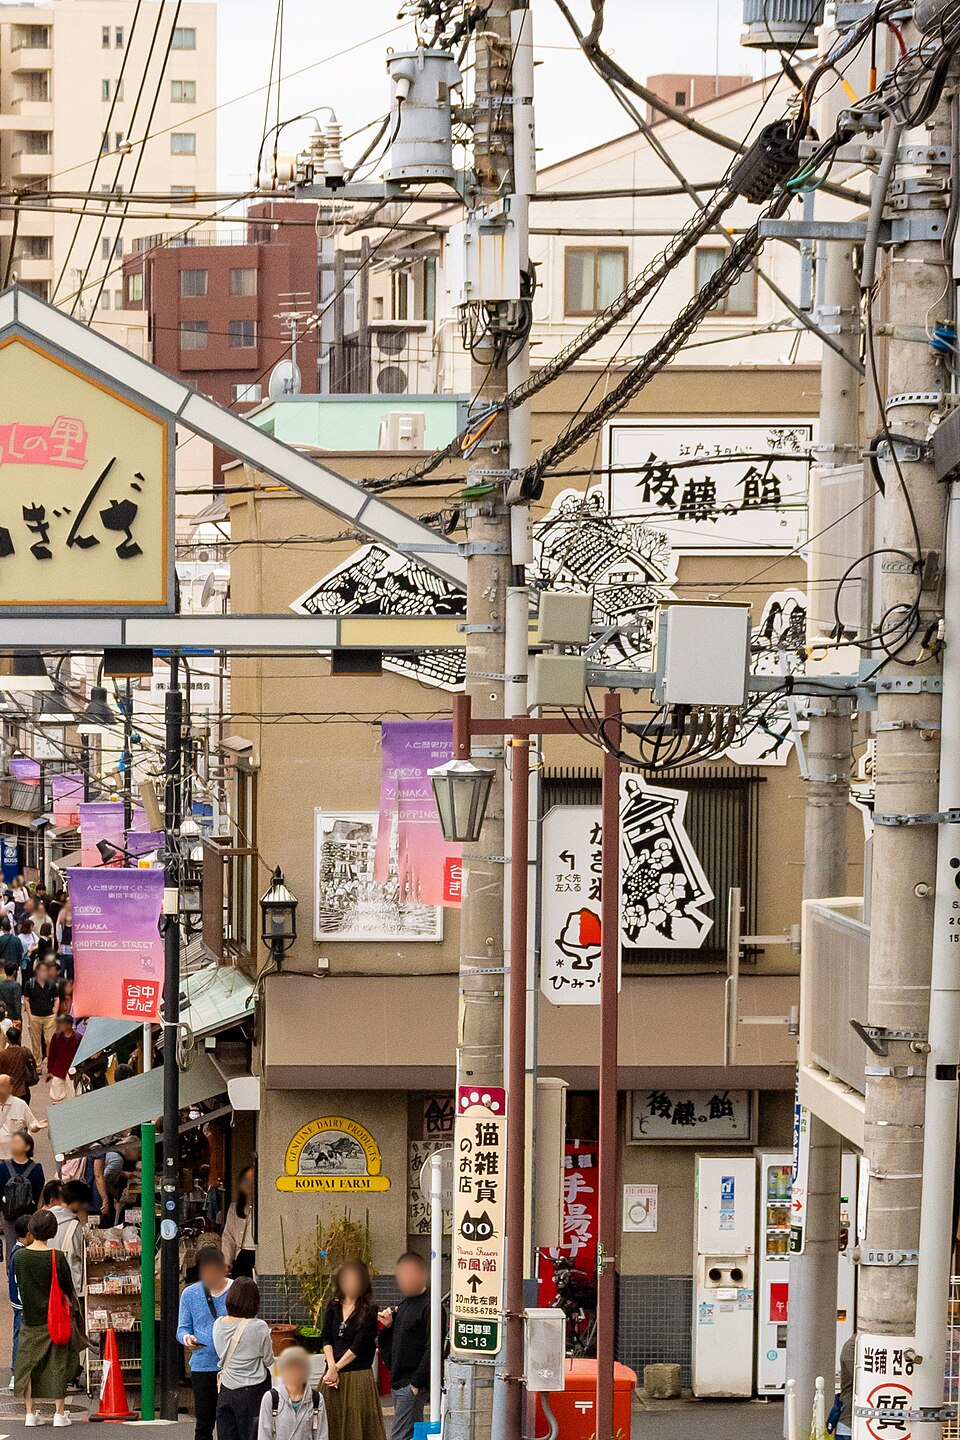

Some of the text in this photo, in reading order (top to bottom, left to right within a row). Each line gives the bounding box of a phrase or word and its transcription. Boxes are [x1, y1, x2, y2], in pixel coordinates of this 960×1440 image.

[635, 451, 782, 525] 後藤の飴
[387, 767, 422, 778] TOKYO
[385, 788, 430, 799] YANAKA
[555, 883, 582, 893] 左入る
[73, 905, 102, 914] TOKYO
[74, 923, 108, 931] YANAKA
[74, 940, 155, 949] SHOPPING STREET
[548, 973, 602, 990] ひみつ
[126, 984, 155, 997] 谷中
[126, 998, 154, 1013] ぎんざ
[288, 1119, 378, 1163] GENUINE DAIRY PRODUCTS
[458, 1137, 473, 1194] のお店
[474, 1122, 500, 1204] 猫雑貨
[295, 1179, 371, 1189] KOIWAI FARM
[410, 1202, 432, 1219] ほうじ
[458, 1323, 492, 1335] 西日暮里
[460, 1336, 488, 1347] 3-13
[862, 1346, 888, 1375] 当铺
[875, 1395, 908, 1431] 質
